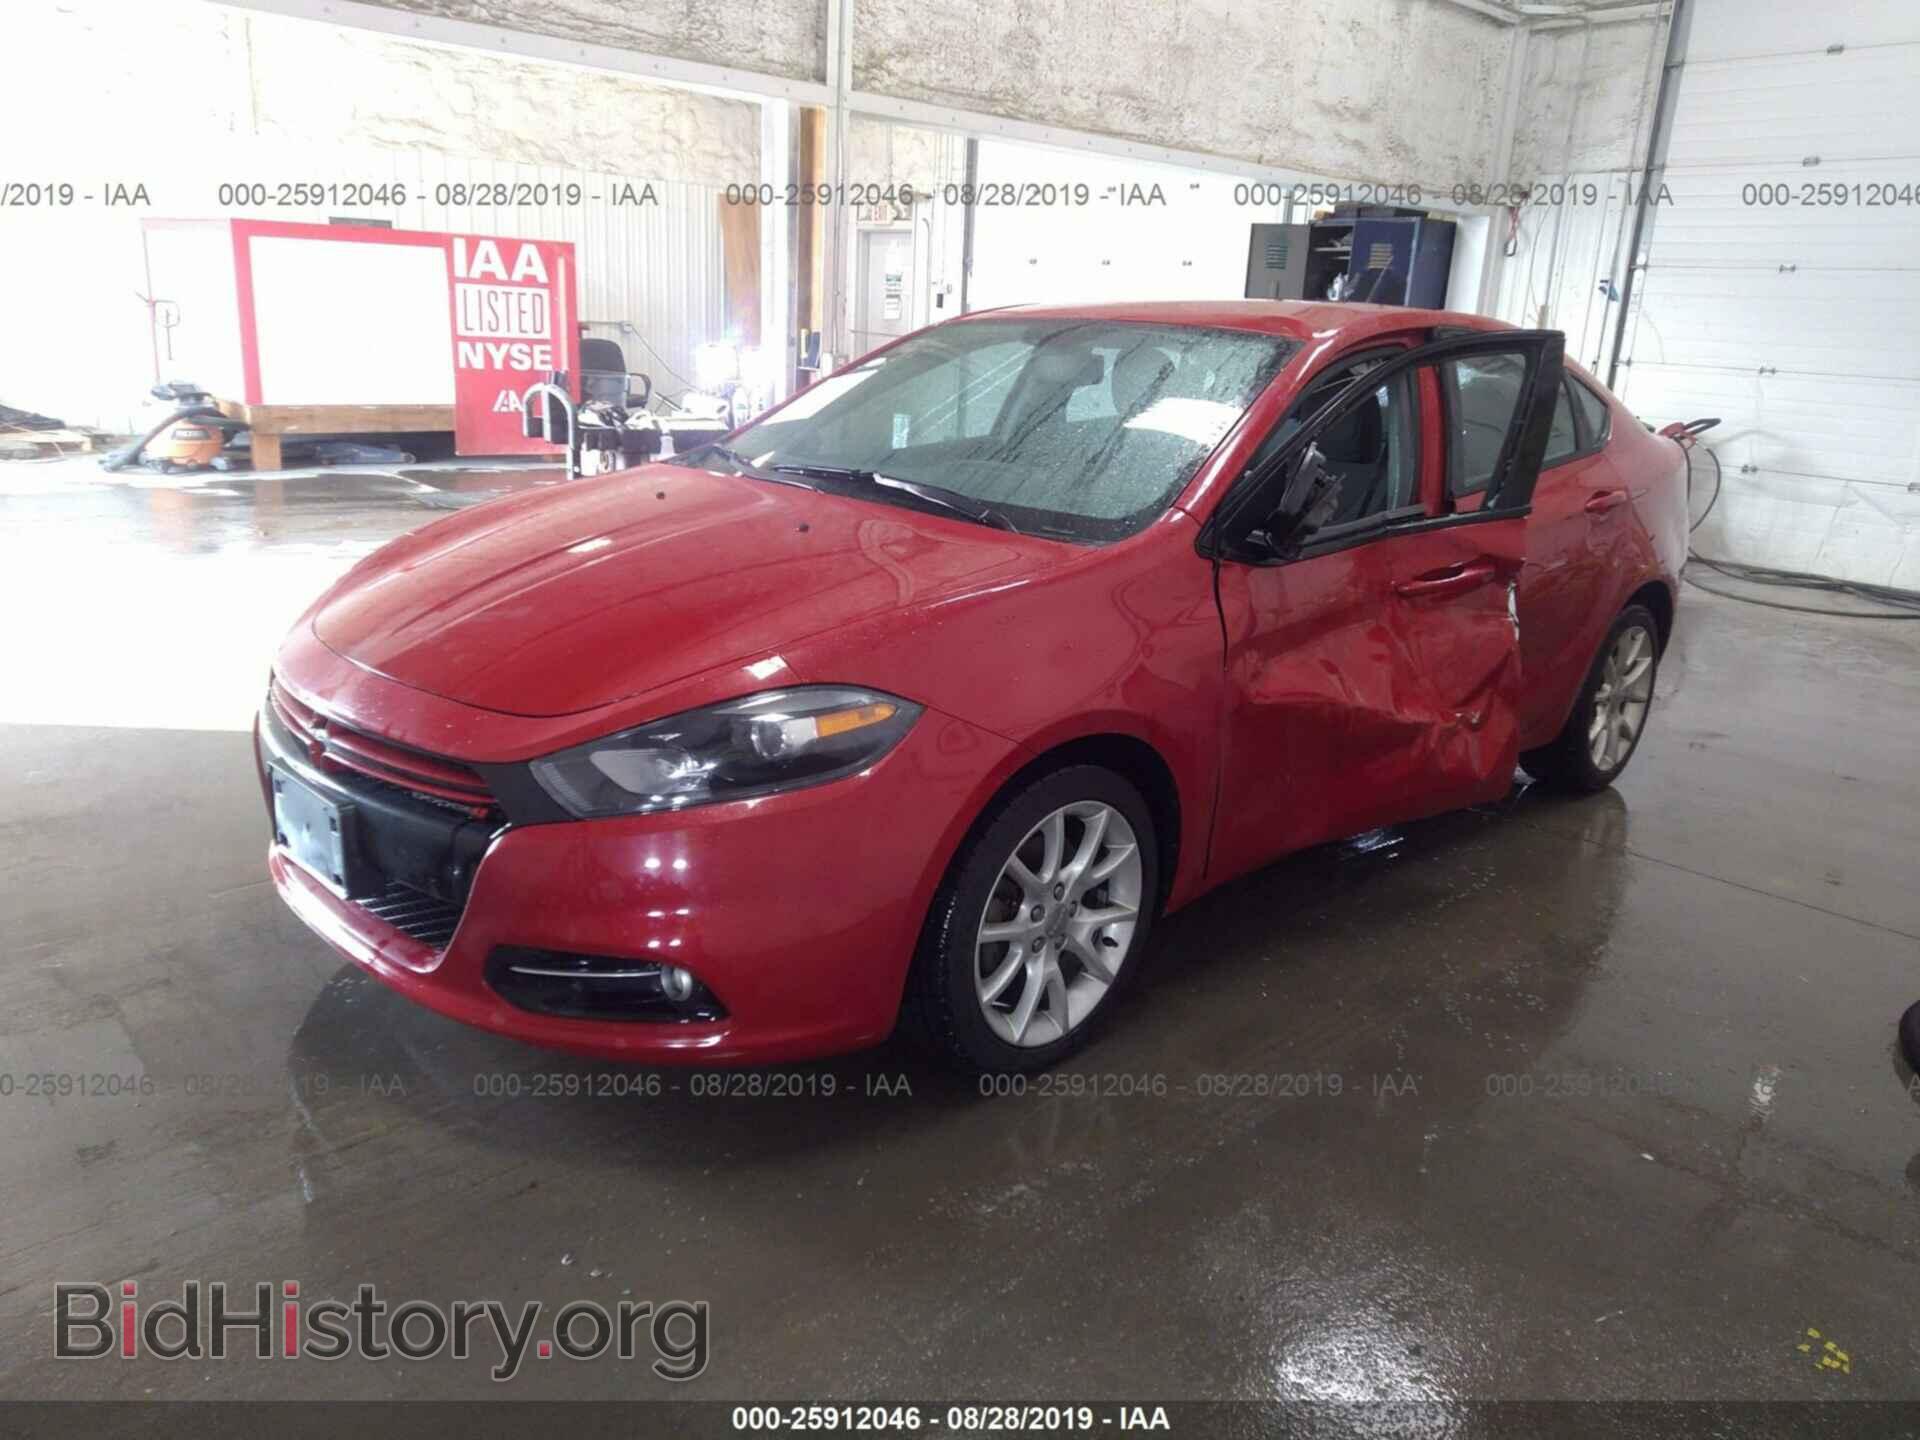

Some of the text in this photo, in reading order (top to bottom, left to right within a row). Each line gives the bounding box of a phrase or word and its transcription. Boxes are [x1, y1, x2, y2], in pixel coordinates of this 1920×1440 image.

[453, 237, 548, 283] IAA
[463, 289, 545, 335] LISTED
[457, 341, 552, 371] NYSE
